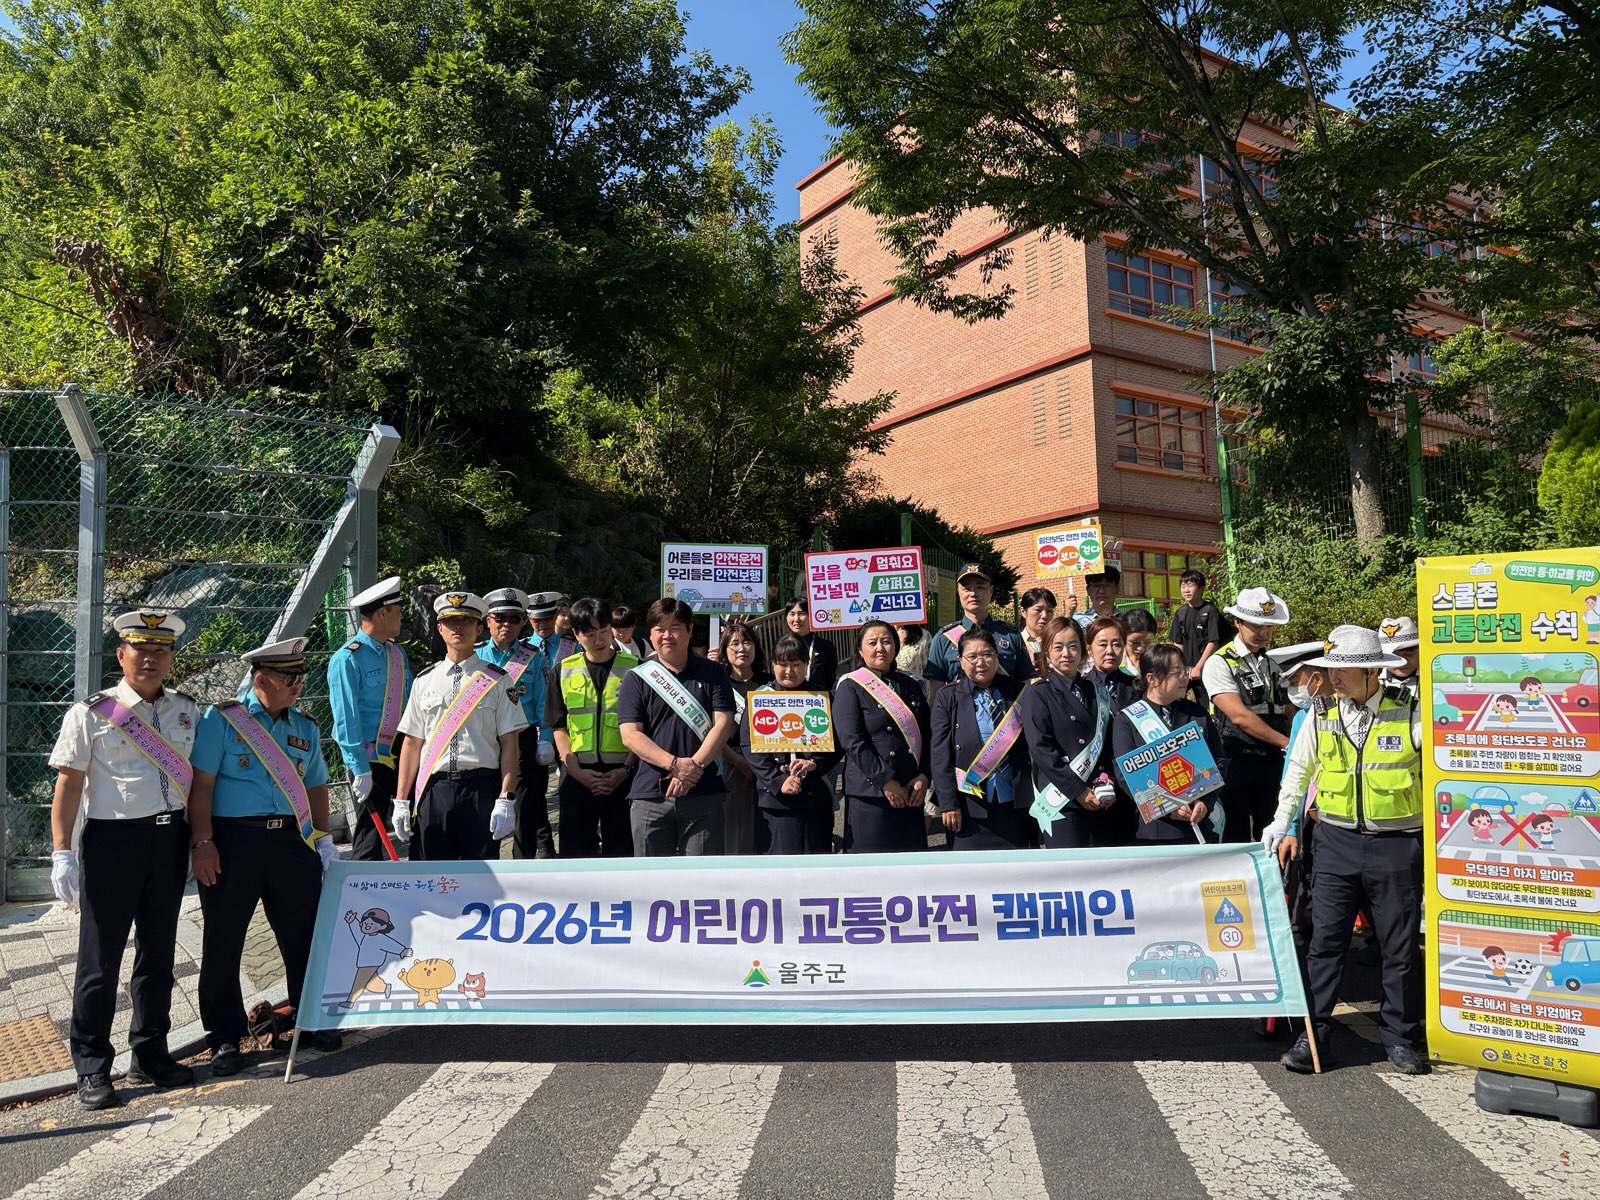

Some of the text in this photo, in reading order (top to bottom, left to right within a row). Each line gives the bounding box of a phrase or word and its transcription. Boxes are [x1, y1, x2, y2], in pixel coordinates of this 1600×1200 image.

[1066, 533, 1079, 541] 안전
[668, 552, 760, 566] 어른들은 안전운전
[1040, 545, 1101, 560] 서다 보다 걷다
[877, 555, 913, 569] 멈춰요
[668, 568, 760, 581] 우리들은 안전보행
[811, 564, 841, 581] 길을
[1510, 565, 1536, 576] 안전한
[1576, 570, 1595, 582] 위한
[812, 582, 859, 600] 건널땐
[878, 576, 915, 590] 살펴요
[879, 595, 917, 609] 건너요
[1432, 581, 1498, 610] 스쿨존
[1432, 610, 1578, 643] 교통안전 수칙
[650, 670, 706, 728] 횡단보도 앞 일단
[754, 699, 824, 707] 횡단보도 안전 약속!
[755, 715, 829, 731] 서다 보다 걷다
[141, 727, 166, 750] 어린이
[1444, 734, 1587, 748] 초록불에 횡단보도로 건너요
[134, 734, 182, 778] 어린이보호구역
[1123, 747, 1157, 773] 어린이
[1156, 727, 1200, 757] 보호구역
[1450, 750, 1477, 758] 초록불에
[1480, 750, 1494, 758] 주변
[1496, 751, 1517, 759] 차량이
[1552, 753, 1582, 762] 확인해요
[1161, 759, 1184, 778] 일단
[1450, 760, 1464, 768] 손을
[1465, 760, 1479, 768] 들고
[1481, 760, 1502, 769] 천천히
[1536, 763, 1558, 771] 살피며
[1560, 764, 1582, 772] 걸어요
[1166, 771, 1192, 791] 멈춤!
[1465, 863, 1574, 882] 무단횡단 하지 말아요
[360, 882, 378, 890] 삶에
[381, 882, 410, 890] 스며드는
[415, 879, 436, 892] 행복
[437, 876, 459, 894] 울주
[1204, 884, 1243, 893] 어린이보호구역
[1452, 878, 1592, 898] 차가 보이지 않더라도 무단횡단은 위험해요
[1514, 894, 1536, 904] 초록색
[1538, 896, 1552, 905] 불에
[1554, 898, 1577, 907] 건너요
[456, 889, 1136, 945] 2026년 어린이 교통안전 캠페인
[1224, 932, 1239, 942] 30
[778, 962, 847, 985] 울주군
[1462, 996, 1583, 1022] 도로에서 놀면 위험해요
[1462, 1012, 1476, 1020] 도로
[1484, 1015, 1512, 1026] 주차장은
[1514, 1019, 1530, 1028] 차가
[1531, 1022, 1553, 1032] 다니는
[1555, 1025, 1586, 1036] 곳이에요
[1469, 1023, 1579, 1046] 친구와 공놀이 등 장난은 위험해요
[1502, 1050, 1568, 1069] 울산경찰청
[1517, 1062, 1550, 1071] Metropolitan
